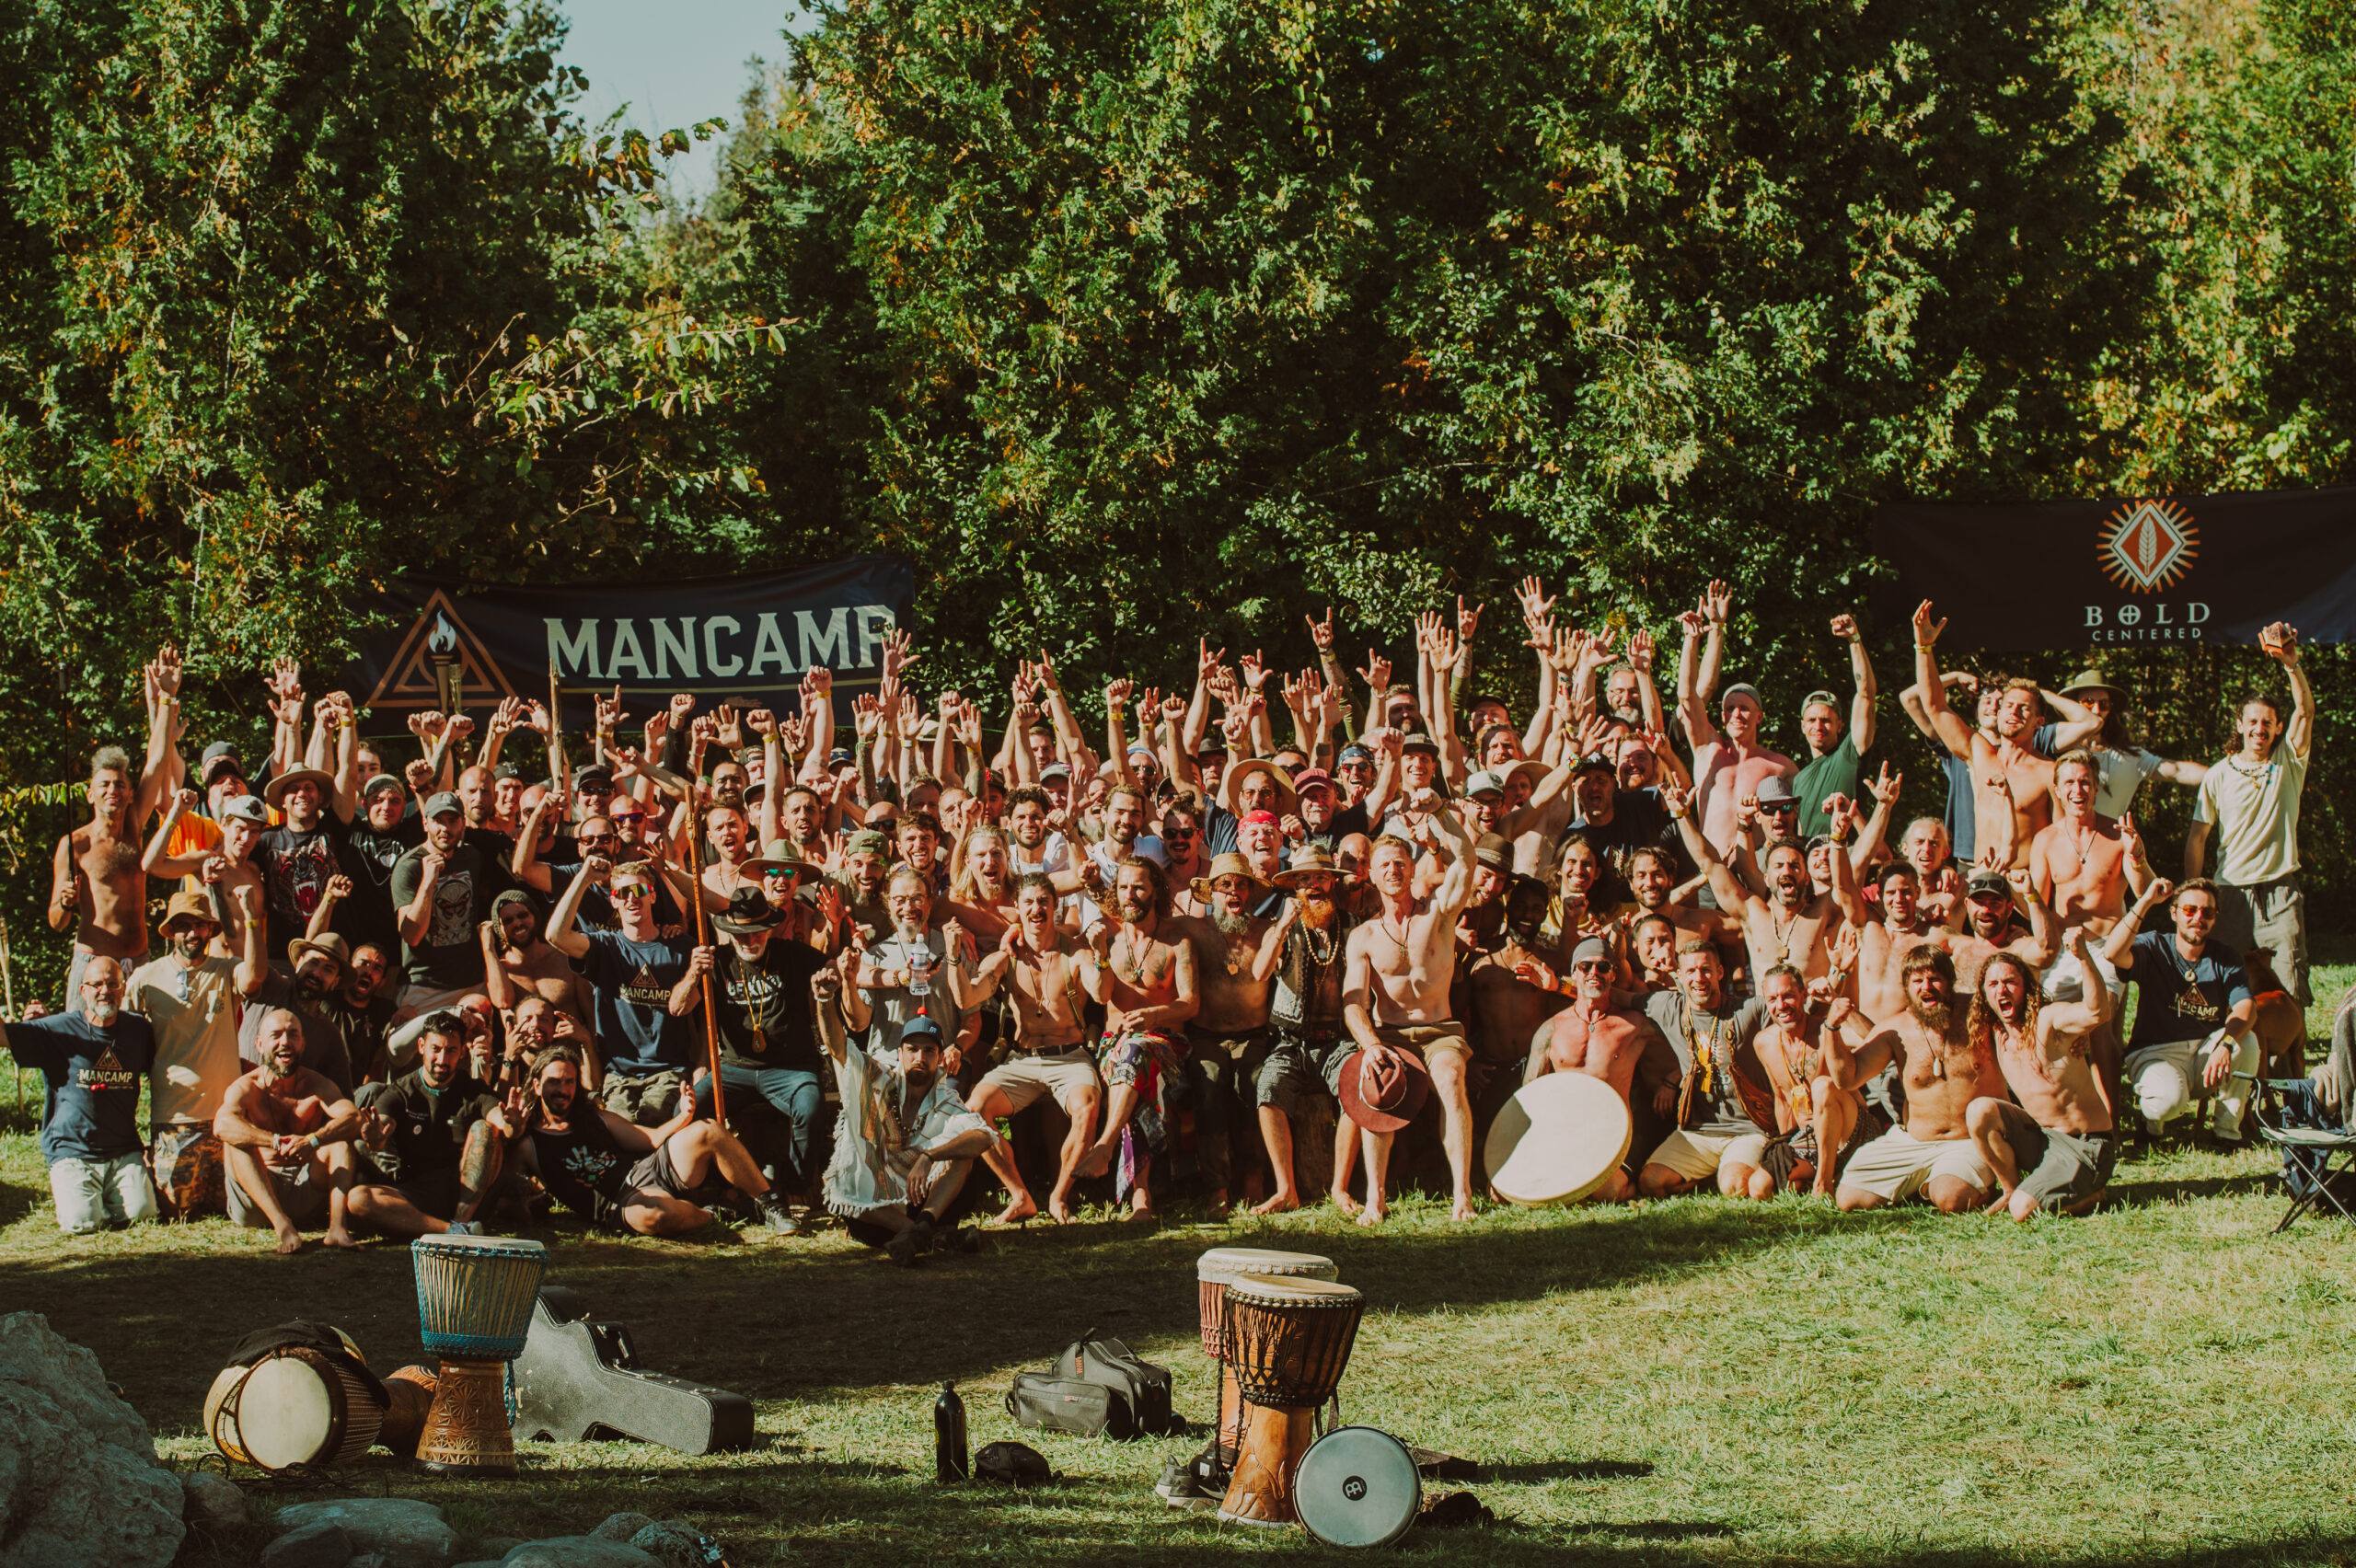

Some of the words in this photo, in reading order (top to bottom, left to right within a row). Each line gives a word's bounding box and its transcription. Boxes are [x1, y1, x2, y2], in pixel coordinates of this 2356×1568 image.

[2084, 602, 2211, 627] BOLD
[543, 604, 896, 679] MANCAMP
[2092, 628, 2201, 641] CENTERED
[78, 1068, 133, 1083] MANCAMP
